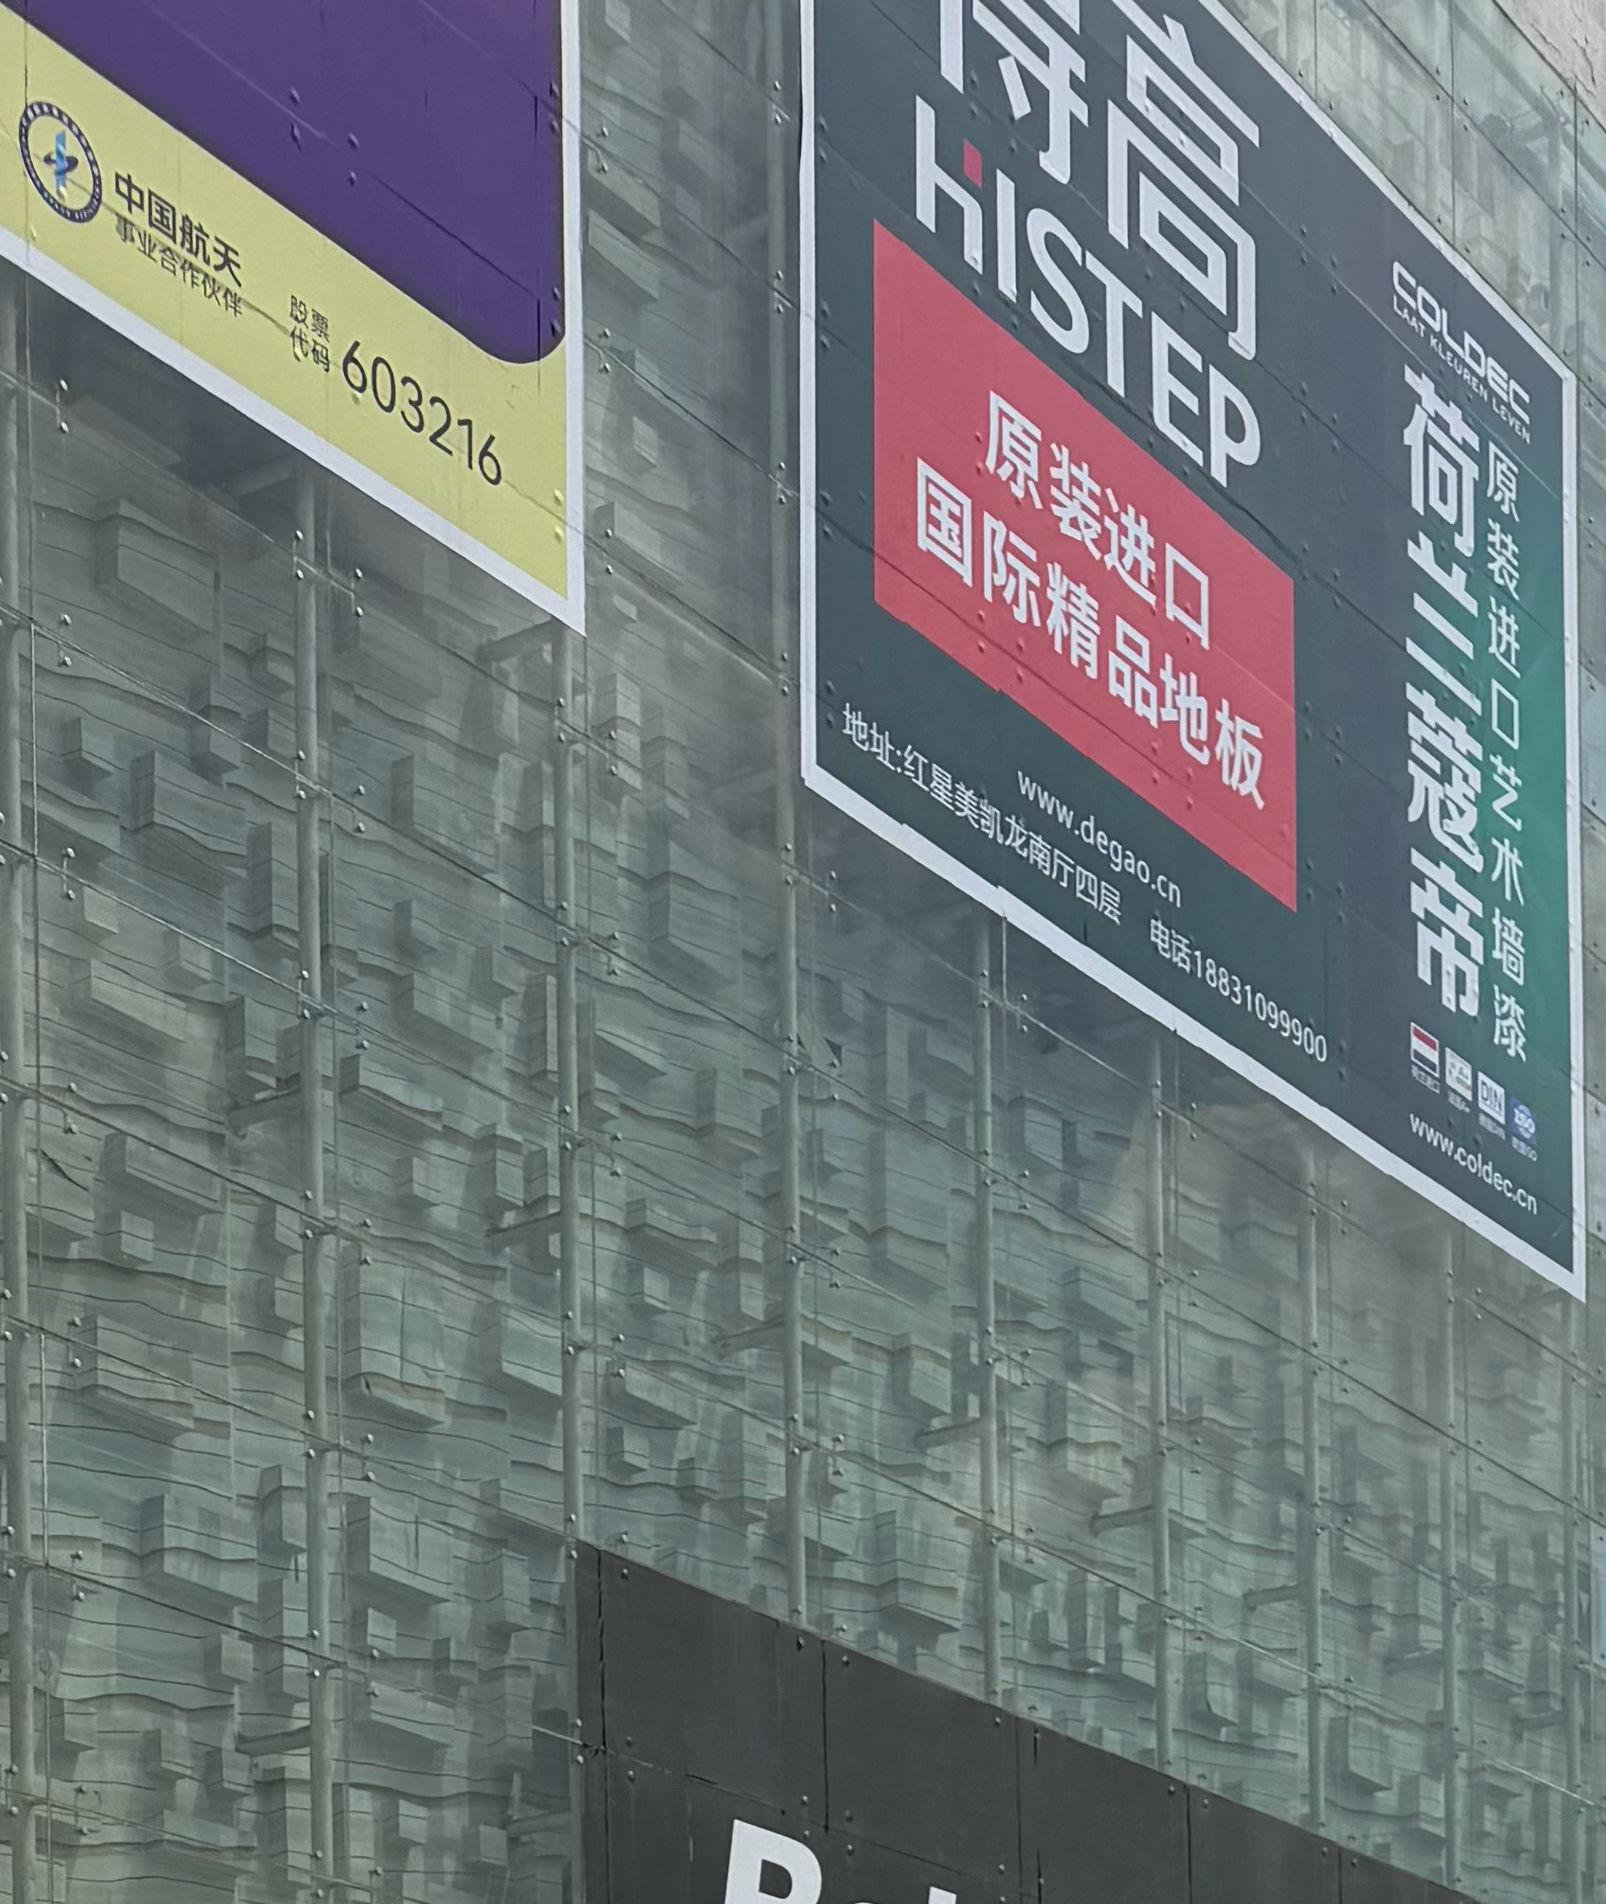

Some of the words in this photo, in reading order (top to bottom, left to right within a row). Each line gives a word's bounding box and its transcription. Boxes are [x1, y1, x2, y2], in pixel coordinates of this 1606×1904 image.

[114, 172, 242, 286] 中国航天
[114, 212, 243, 319] 事业合作伙伴
[915, 95, 1261, 488] HISTEP
[290, 295, 330, 343] 股票
[290, 326, 330, 373] 代码
[1393, 261, 1530, 425] COLDEC
[1393, 294, 1425, 337] LAAT
[1430, 335, 1488, 402] KLEUREN
[1492, 397, 1531, 444] LEVEN
[342, 340, 502, 486] 603216
[985, 390, 1210, 650] 原装进口
[917, 457, 1265, 810] 国际精品地板
[1402, 363, 1484, 1017] 荷兰蔻帝
[1487, 441, 1526, 1062] 原装进口艺术墙漆
[1018, 771, 1181, 908] www.degao.cn
[1409, 1113, 1537, 1215] www.coldec.cn
